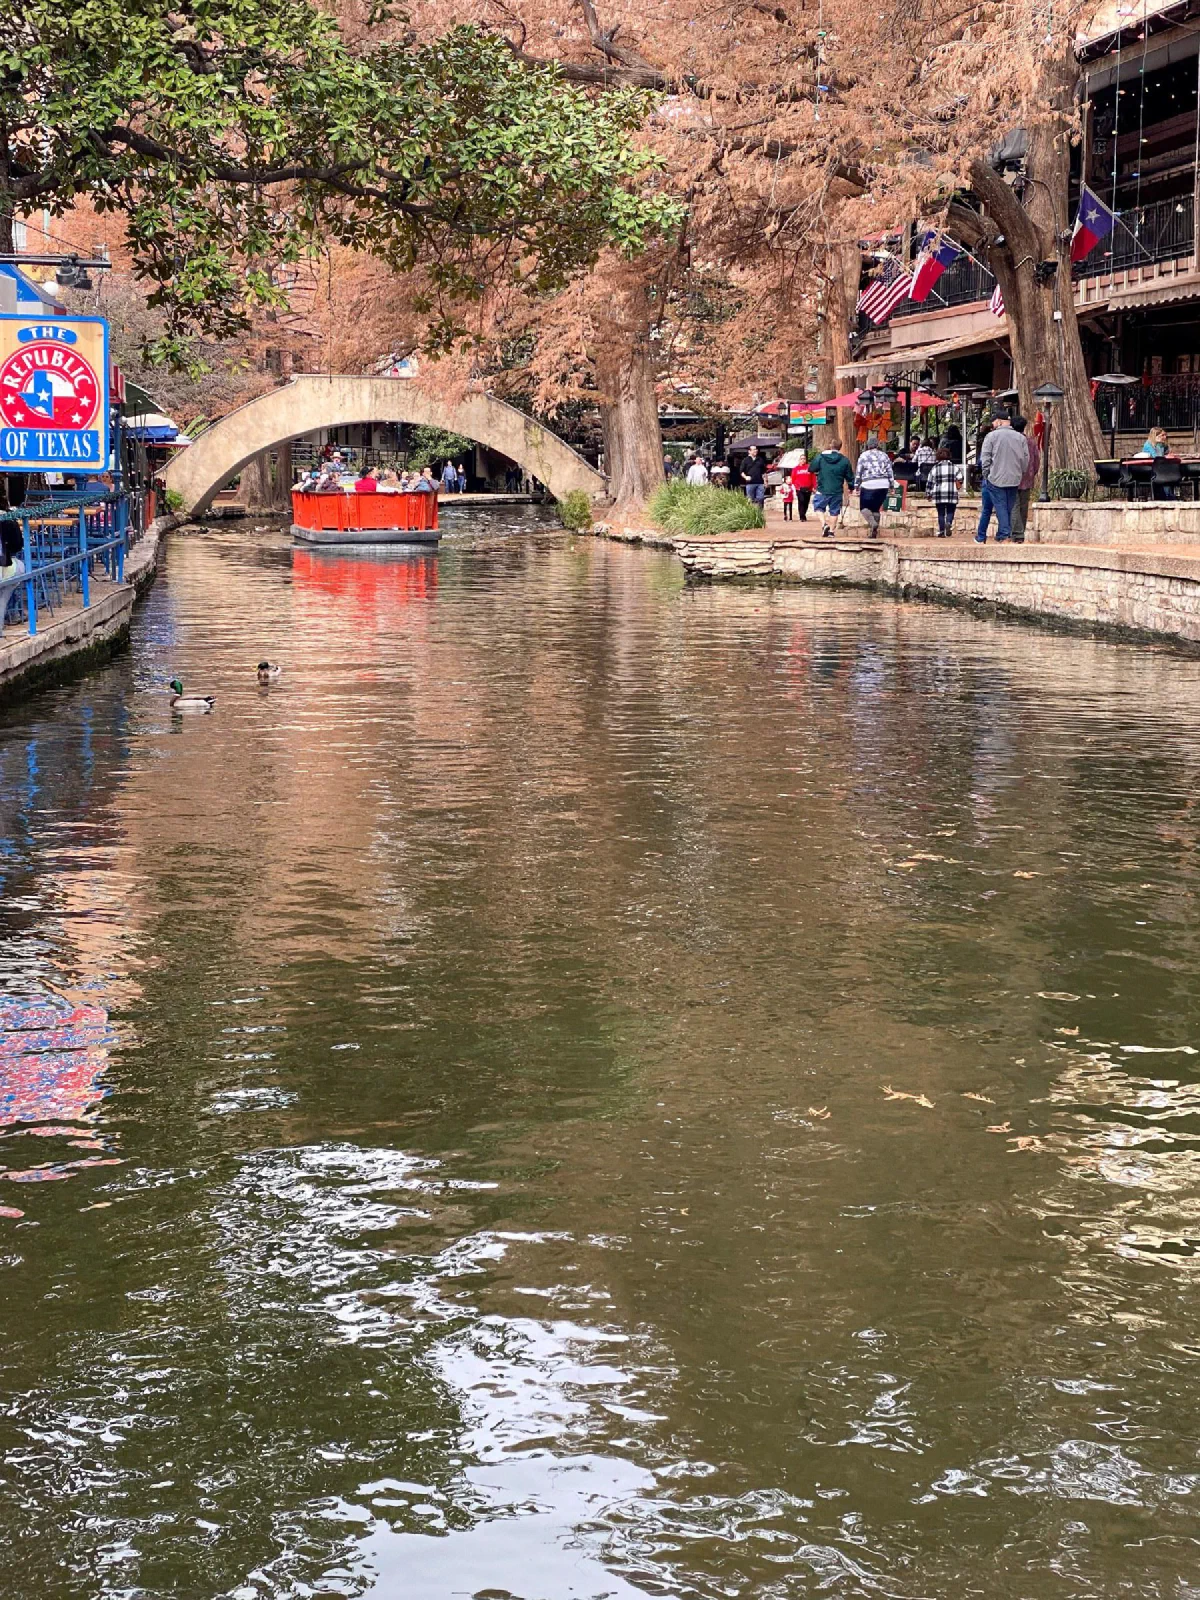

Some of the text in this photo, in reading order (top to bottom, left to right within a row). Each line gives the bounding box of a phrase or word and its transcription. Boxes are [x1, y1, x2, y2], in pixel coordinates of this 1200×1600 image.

[28, 327, 67, 340] THE
[2, 349, 92, 389] REPUBLIC
[5, 431, 92, 458] OF TEXAS
